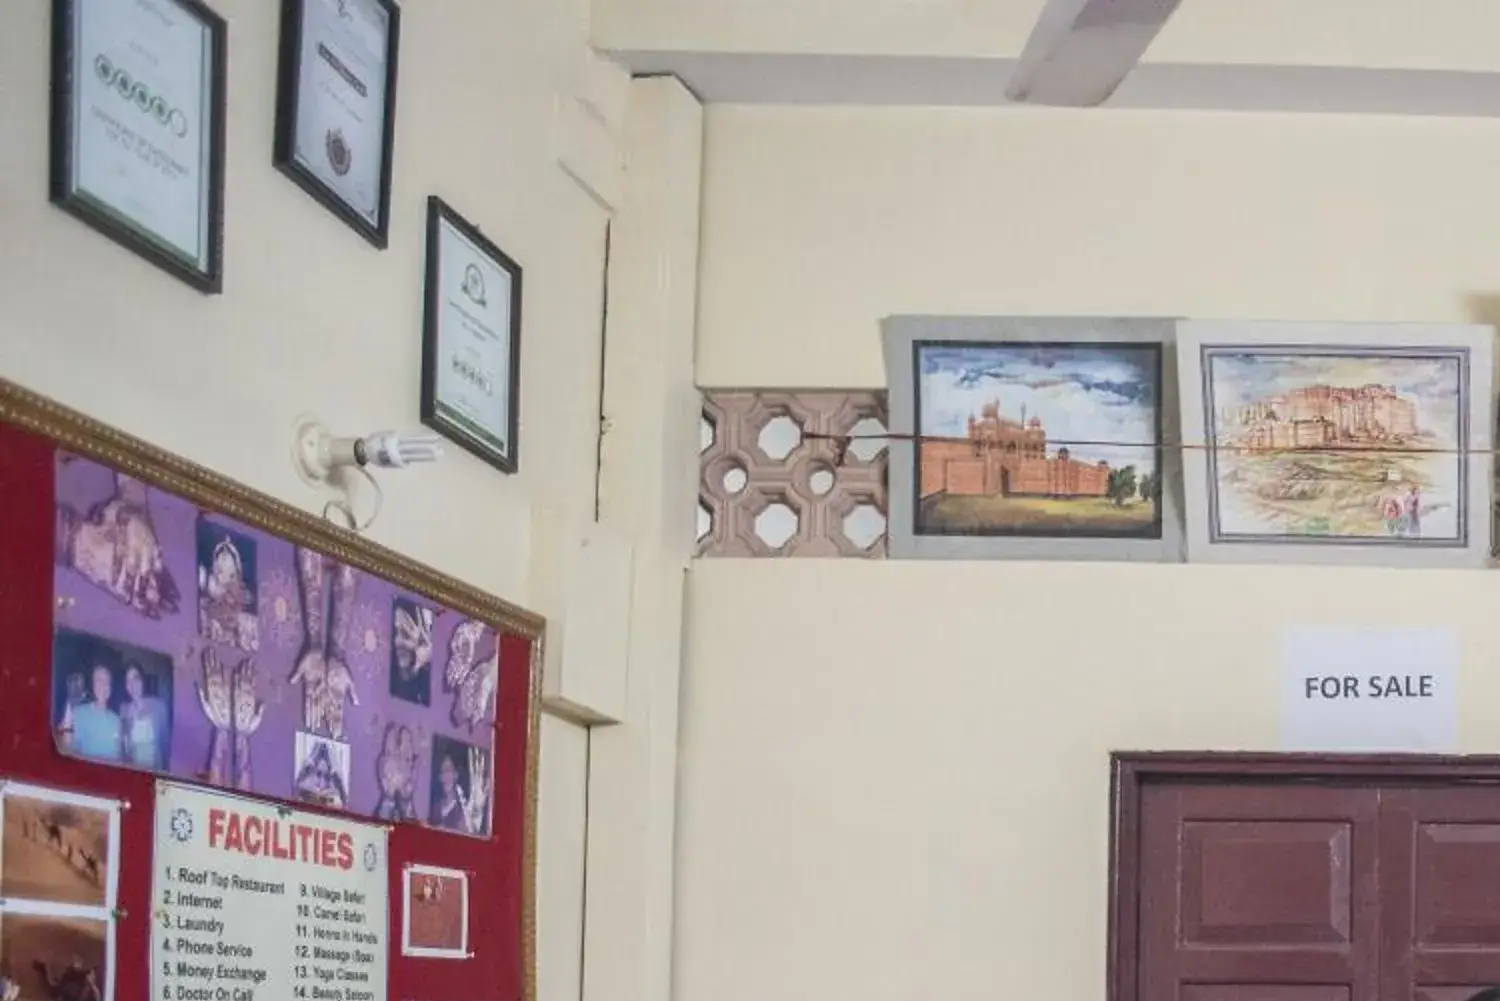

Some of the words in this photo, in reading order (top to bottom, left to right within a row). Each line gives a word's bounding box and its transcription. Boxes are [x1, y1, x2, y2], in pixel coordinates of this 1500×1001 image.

[1305, 676, 1360, 698] FOR
[1368, 675, 1433, 697] SALE
[207, 807, 355, 870] FACILITIES
[178, 867, 208, 885] Roof
[231, 874, 285, 894] Restaurant
[177, 891, 223, 909] Internet
[177, 915, 225, 936] Laundry
[176, 937, 214, 955] Phone
[216, 941, 254, 957] Service
[177, 962, 215, 982] Money
[216, 964, 268, 985] Exchange
[177, 985, 213, 1001] Doctor
[215, 986, 231, 1001] On
[233, 987, 253, 1001] Call
